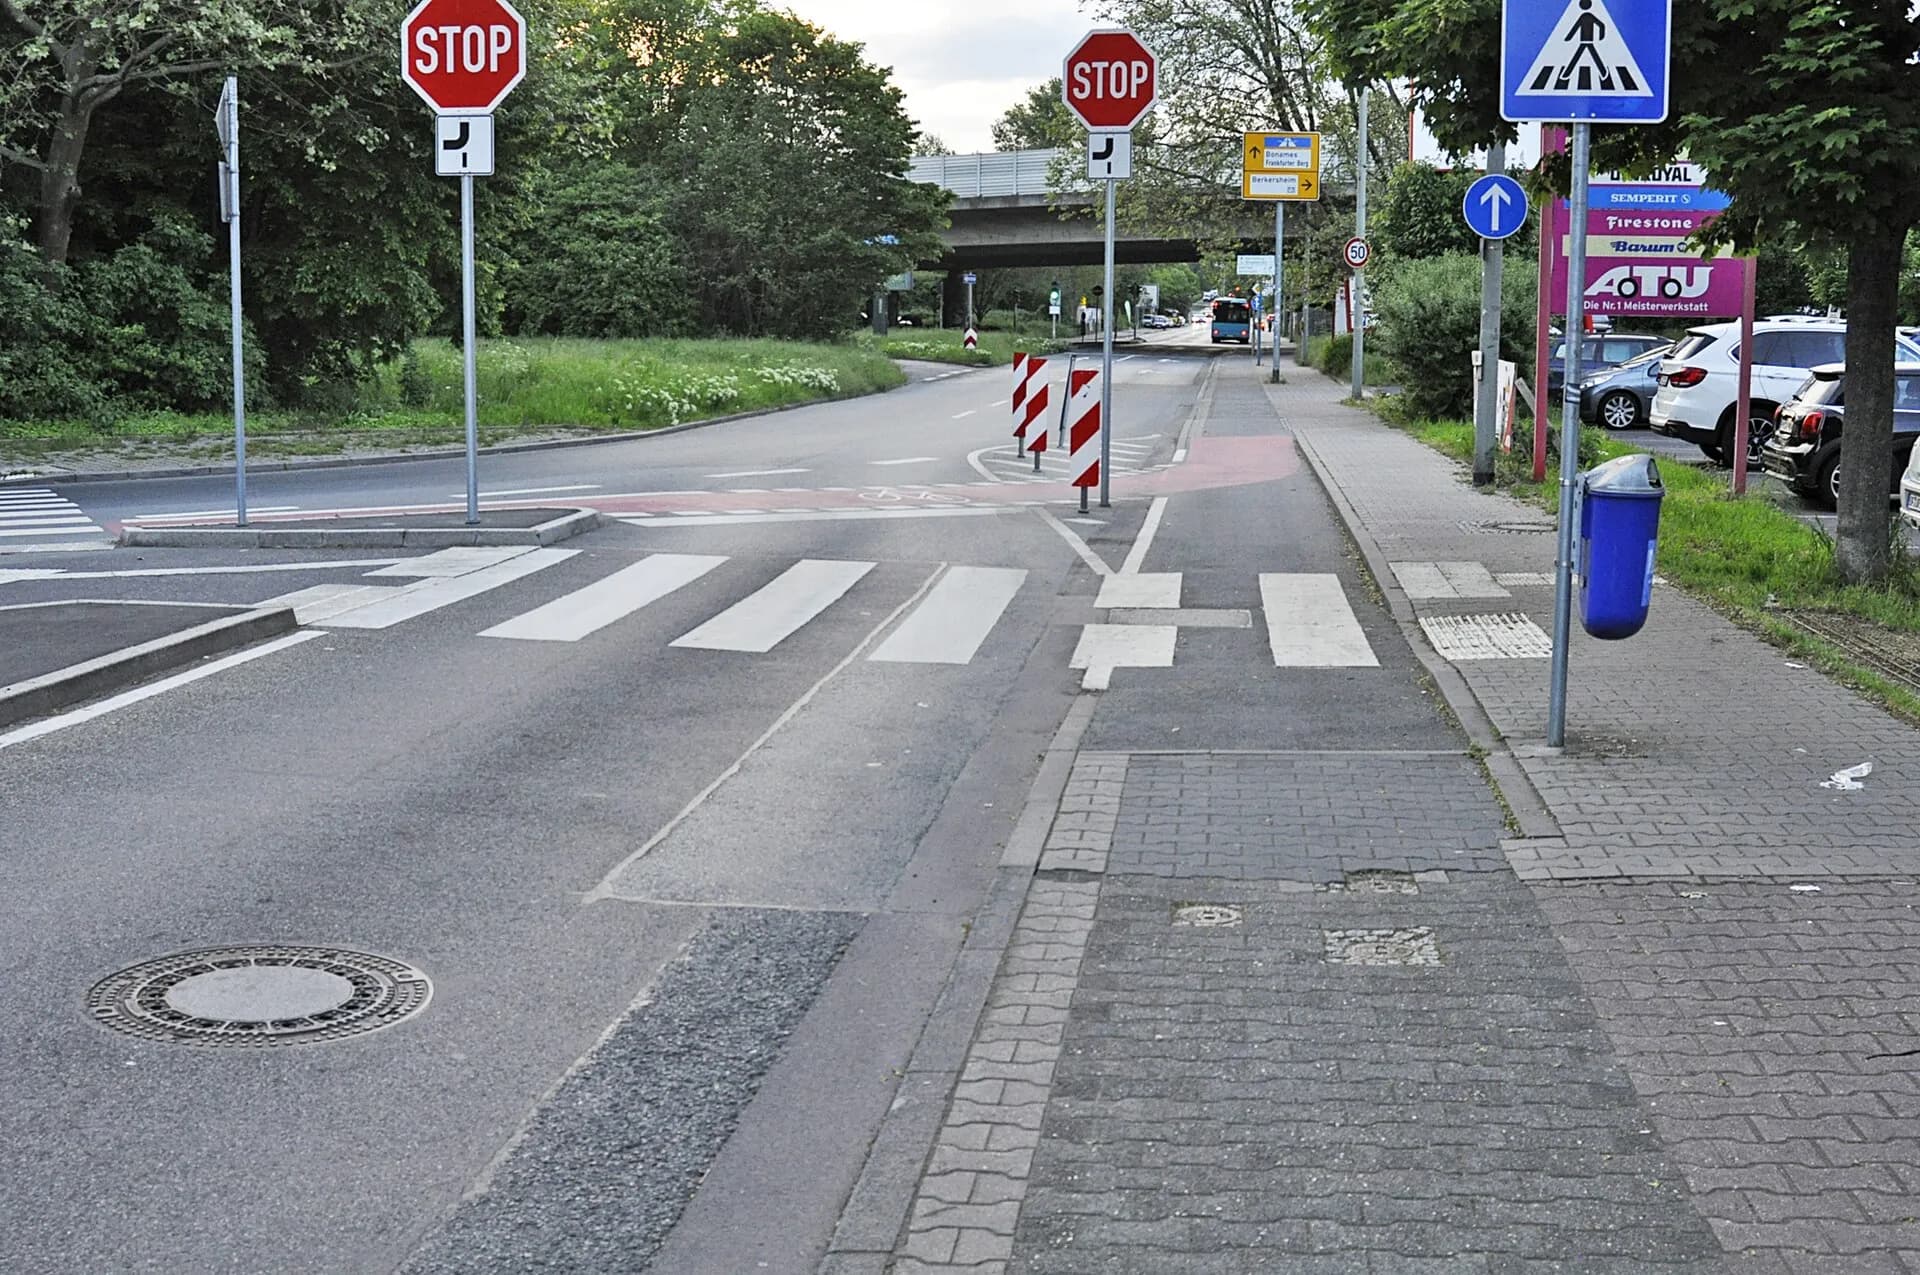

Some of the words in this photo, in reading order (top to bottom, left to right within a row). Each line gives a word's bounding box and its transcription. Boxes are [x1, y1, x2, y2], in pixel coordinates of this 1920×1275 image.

[415, 25, 512, 74] STOP
[1073, 60, 1148, 99] STOP
[1265, 150, 1298, 158] Bonames
[1297, 160, 1309, 168] Berg
[1252, 175, 1297, 184] Berkersheim
[1610, 166, 1692, 182] UOYAL
[1611, 193, 1678, 203] SEMPERIT
[1606, 215, 1692, 230] Firestone
[1350, 245, 1365, 259] 50
[1610, 240, 1675, 253] Barum
[1583, 300, 1599, 310] Die
[1623, 301, 1708, 312] Meisterwerkstatt
